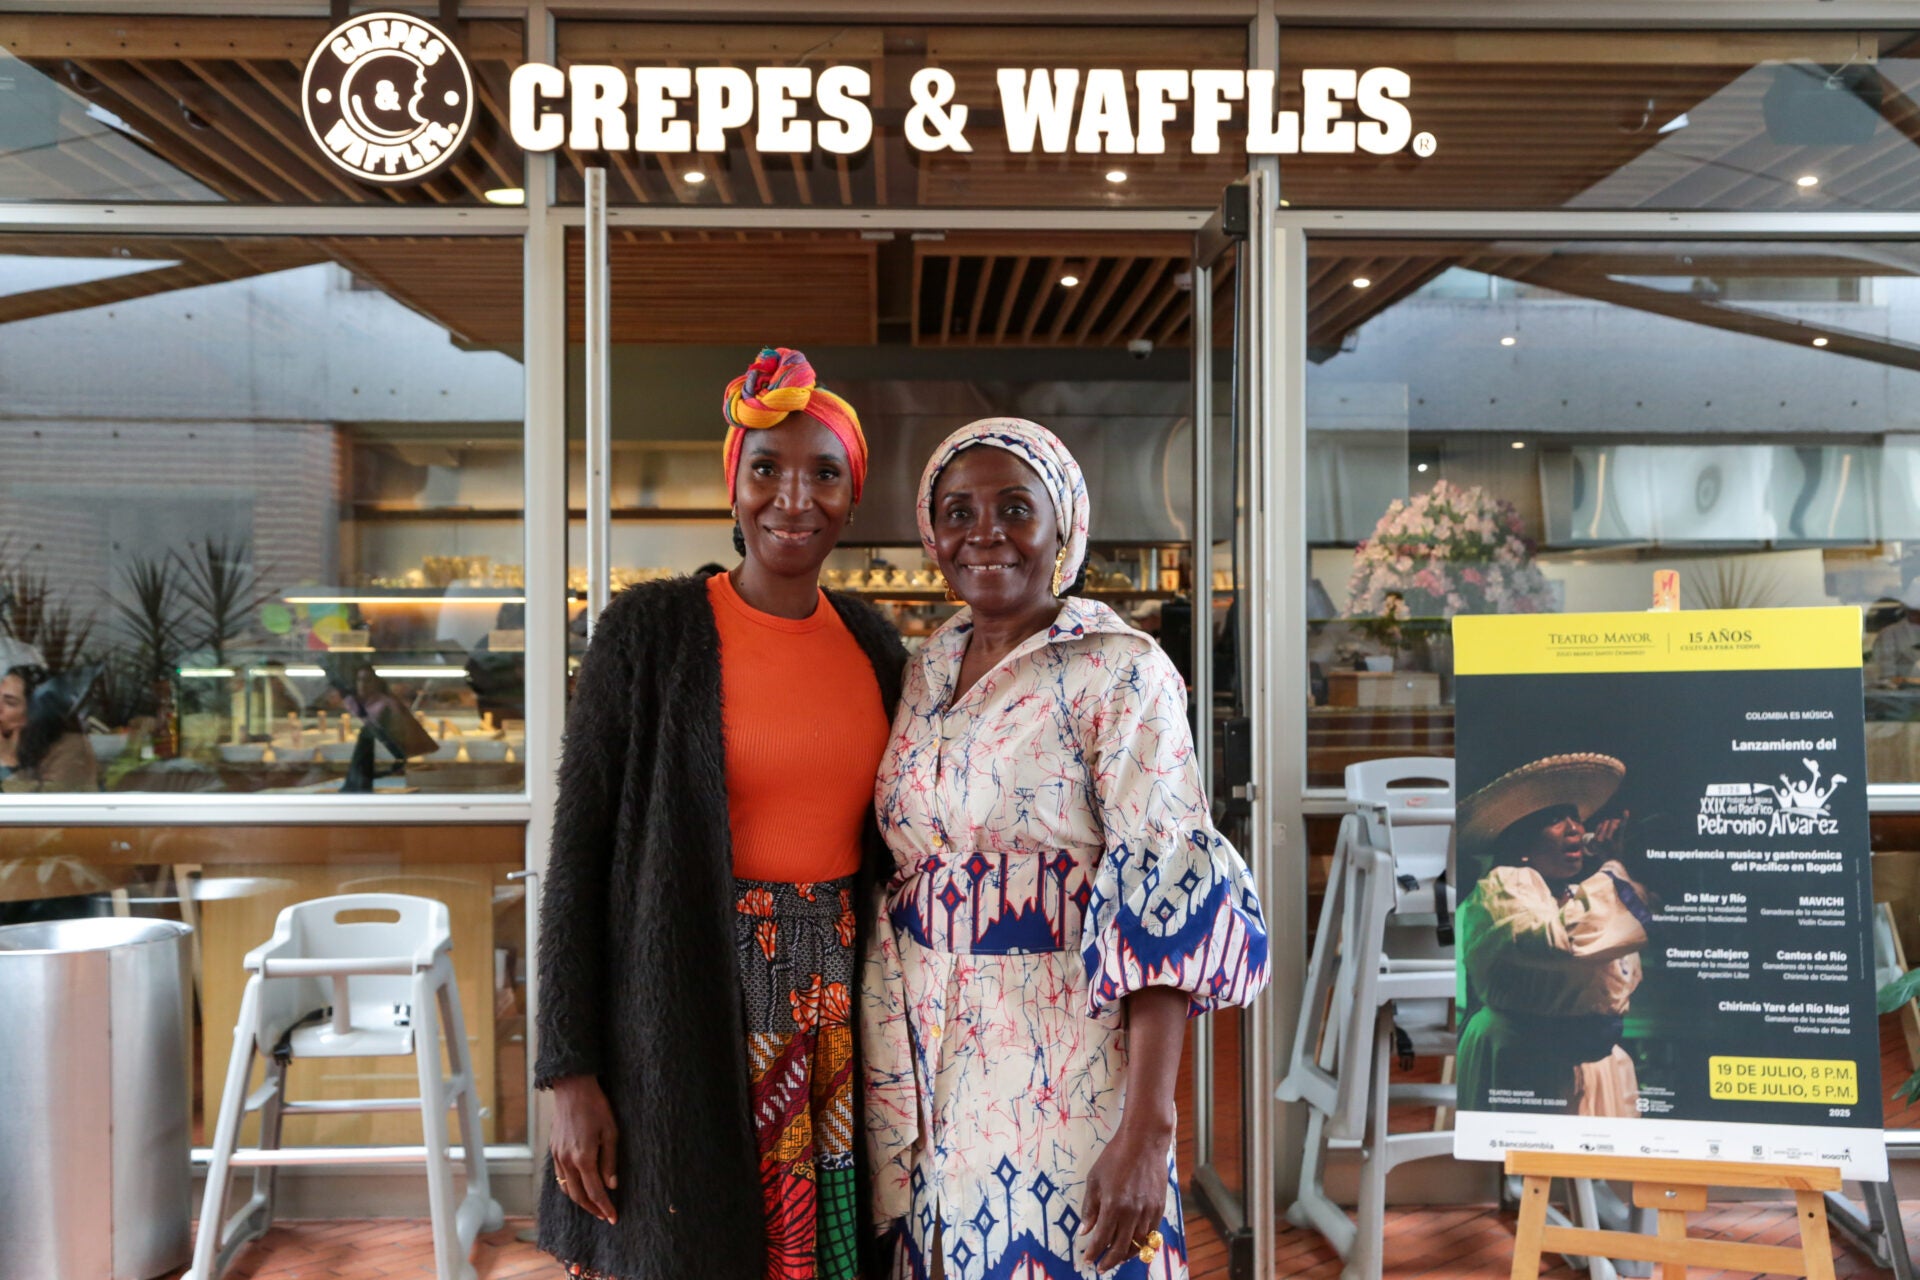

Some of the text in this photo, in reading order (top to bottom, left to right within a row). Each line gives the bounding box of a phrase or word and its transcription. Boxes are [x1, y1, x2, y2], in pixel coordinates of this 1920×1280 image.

[331, 20, 445, 65] CREPES
[375, 79, 401, 111] &
[510, 63, 873, 154] CREPES
[904, 67, 973, 152] &
[997, 67, 1412, 154] WAFFLES
[324, 119, 453, 173] WAFFLES
[1689, 628, 1752, 643] 15 AÑOS
[1745, 710, 1834, 720] COLOMBIA ES MÚSICA
[1732, 738, 1837, 751] Lanzamiento del
[1700, 797, 1726, 814] XXIX
[1697, 813, 1767, 835] Petronio
[1646, 849, 1842, 861] Una experiencia musica y gastronómica
[1731, 861, 1843, 874] del Pacífico en Bogotá
[1684, 893, 1747, 905] De Mar y Río
[1799, 896, 1844, 906] MAVICHI
[1666, 948, 1749, 960] Chureo Callejero
[1776, 950, 1847, 961] Cantos de Río
[1718, 1001, 1850, 1016] Chirimía Yare del Río Napi
[1718, 1063, 1853, 1080] 19 DE JULIO, 8 P.M.
[1715, 1081, 1854, 1098] 20 DE JULIO, 5 P.M.
[1829, 1108, 1850, 1117] 2025
